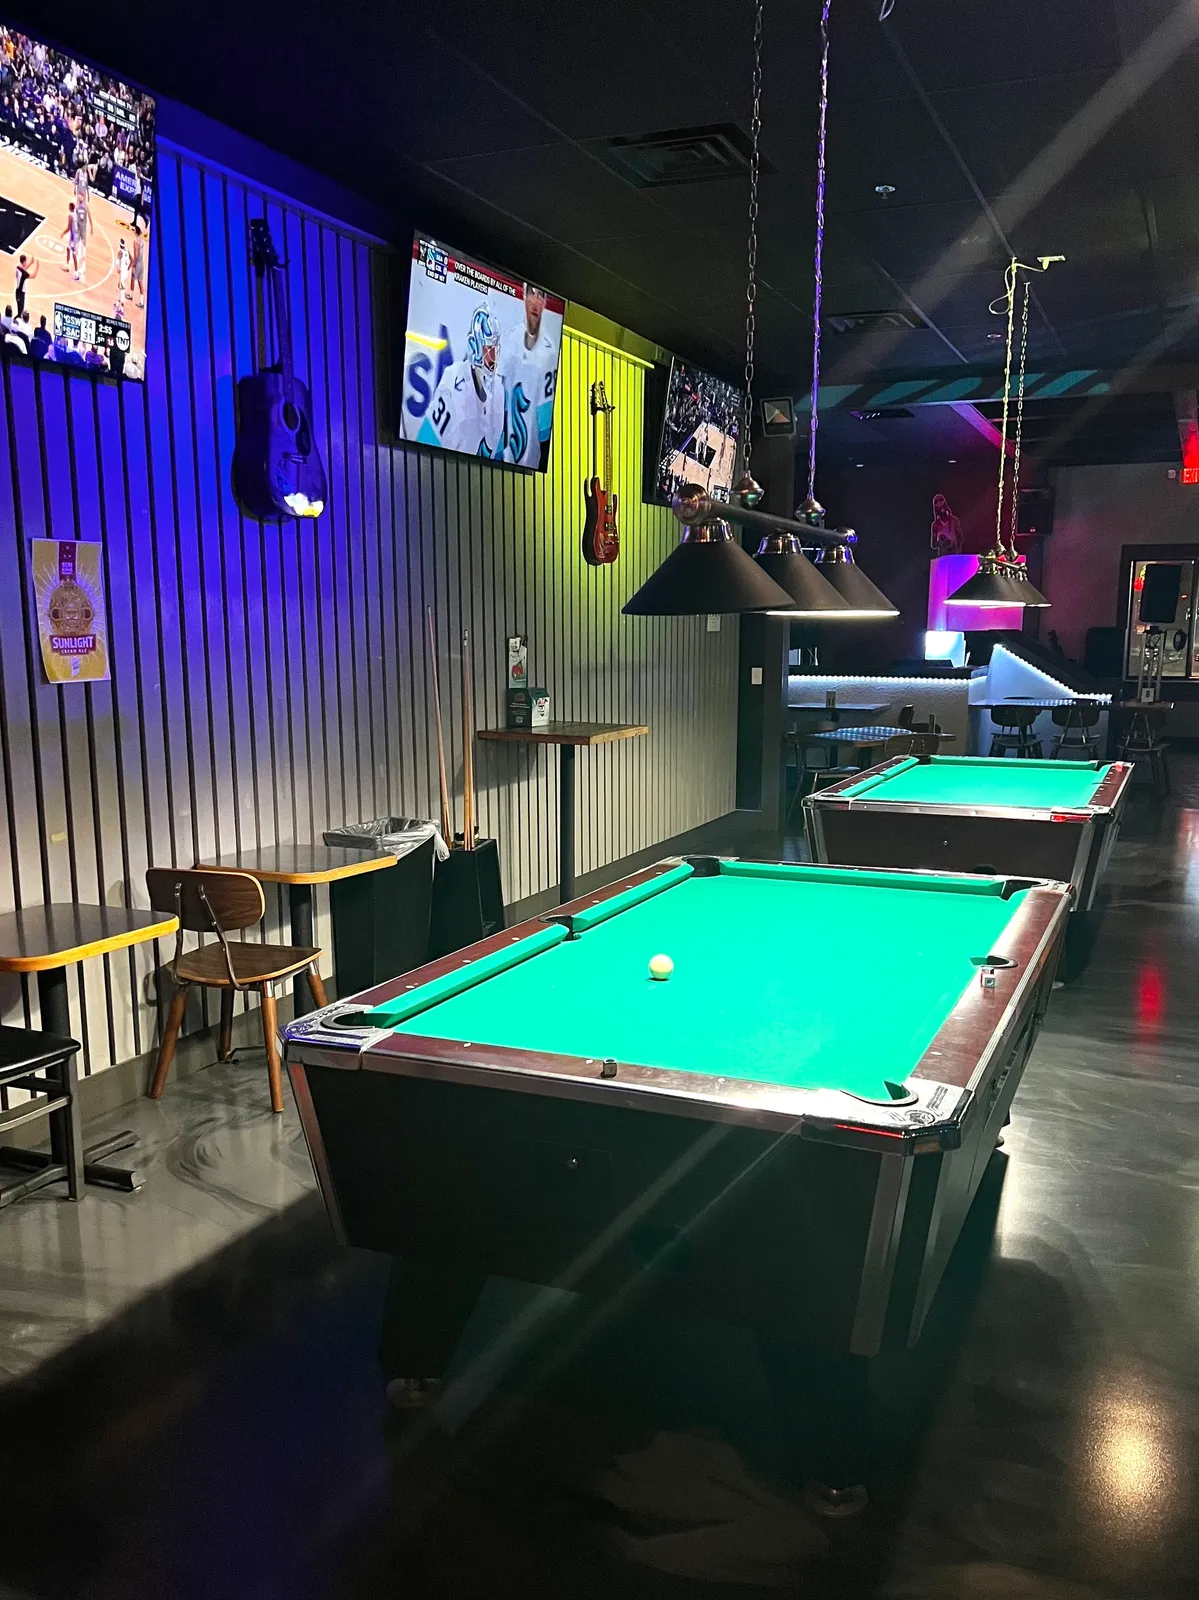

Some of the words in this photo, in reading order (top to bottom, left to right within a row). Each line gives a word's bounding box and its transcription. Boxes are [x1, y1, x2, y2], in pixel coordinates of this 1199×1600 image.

[454, 261, 466, 273] OVER
[466, 267, 475, 278] THE
[474, 270, 490, 284] BOARDS
[490, 277, 496, 287] BY
[495, 280, 503, 290] ALL
[502, 284, 509, 292] OF
[508, 287, 516, 296] THE
[454, 273, 471, 287] KRAKEN
[470, 280, 488, 294] PLAYERS
[65, 315, 81, 327] GSW
[84, 320, 93, 330] 24
[66, 327, 80, 338] SAC
[84, 331, 92, 342] 31
[432, 396, 451, 438] 31
[1183, 467, 1199, 483] EXI
[52, 636, 94, 649] SUNLIGHT
